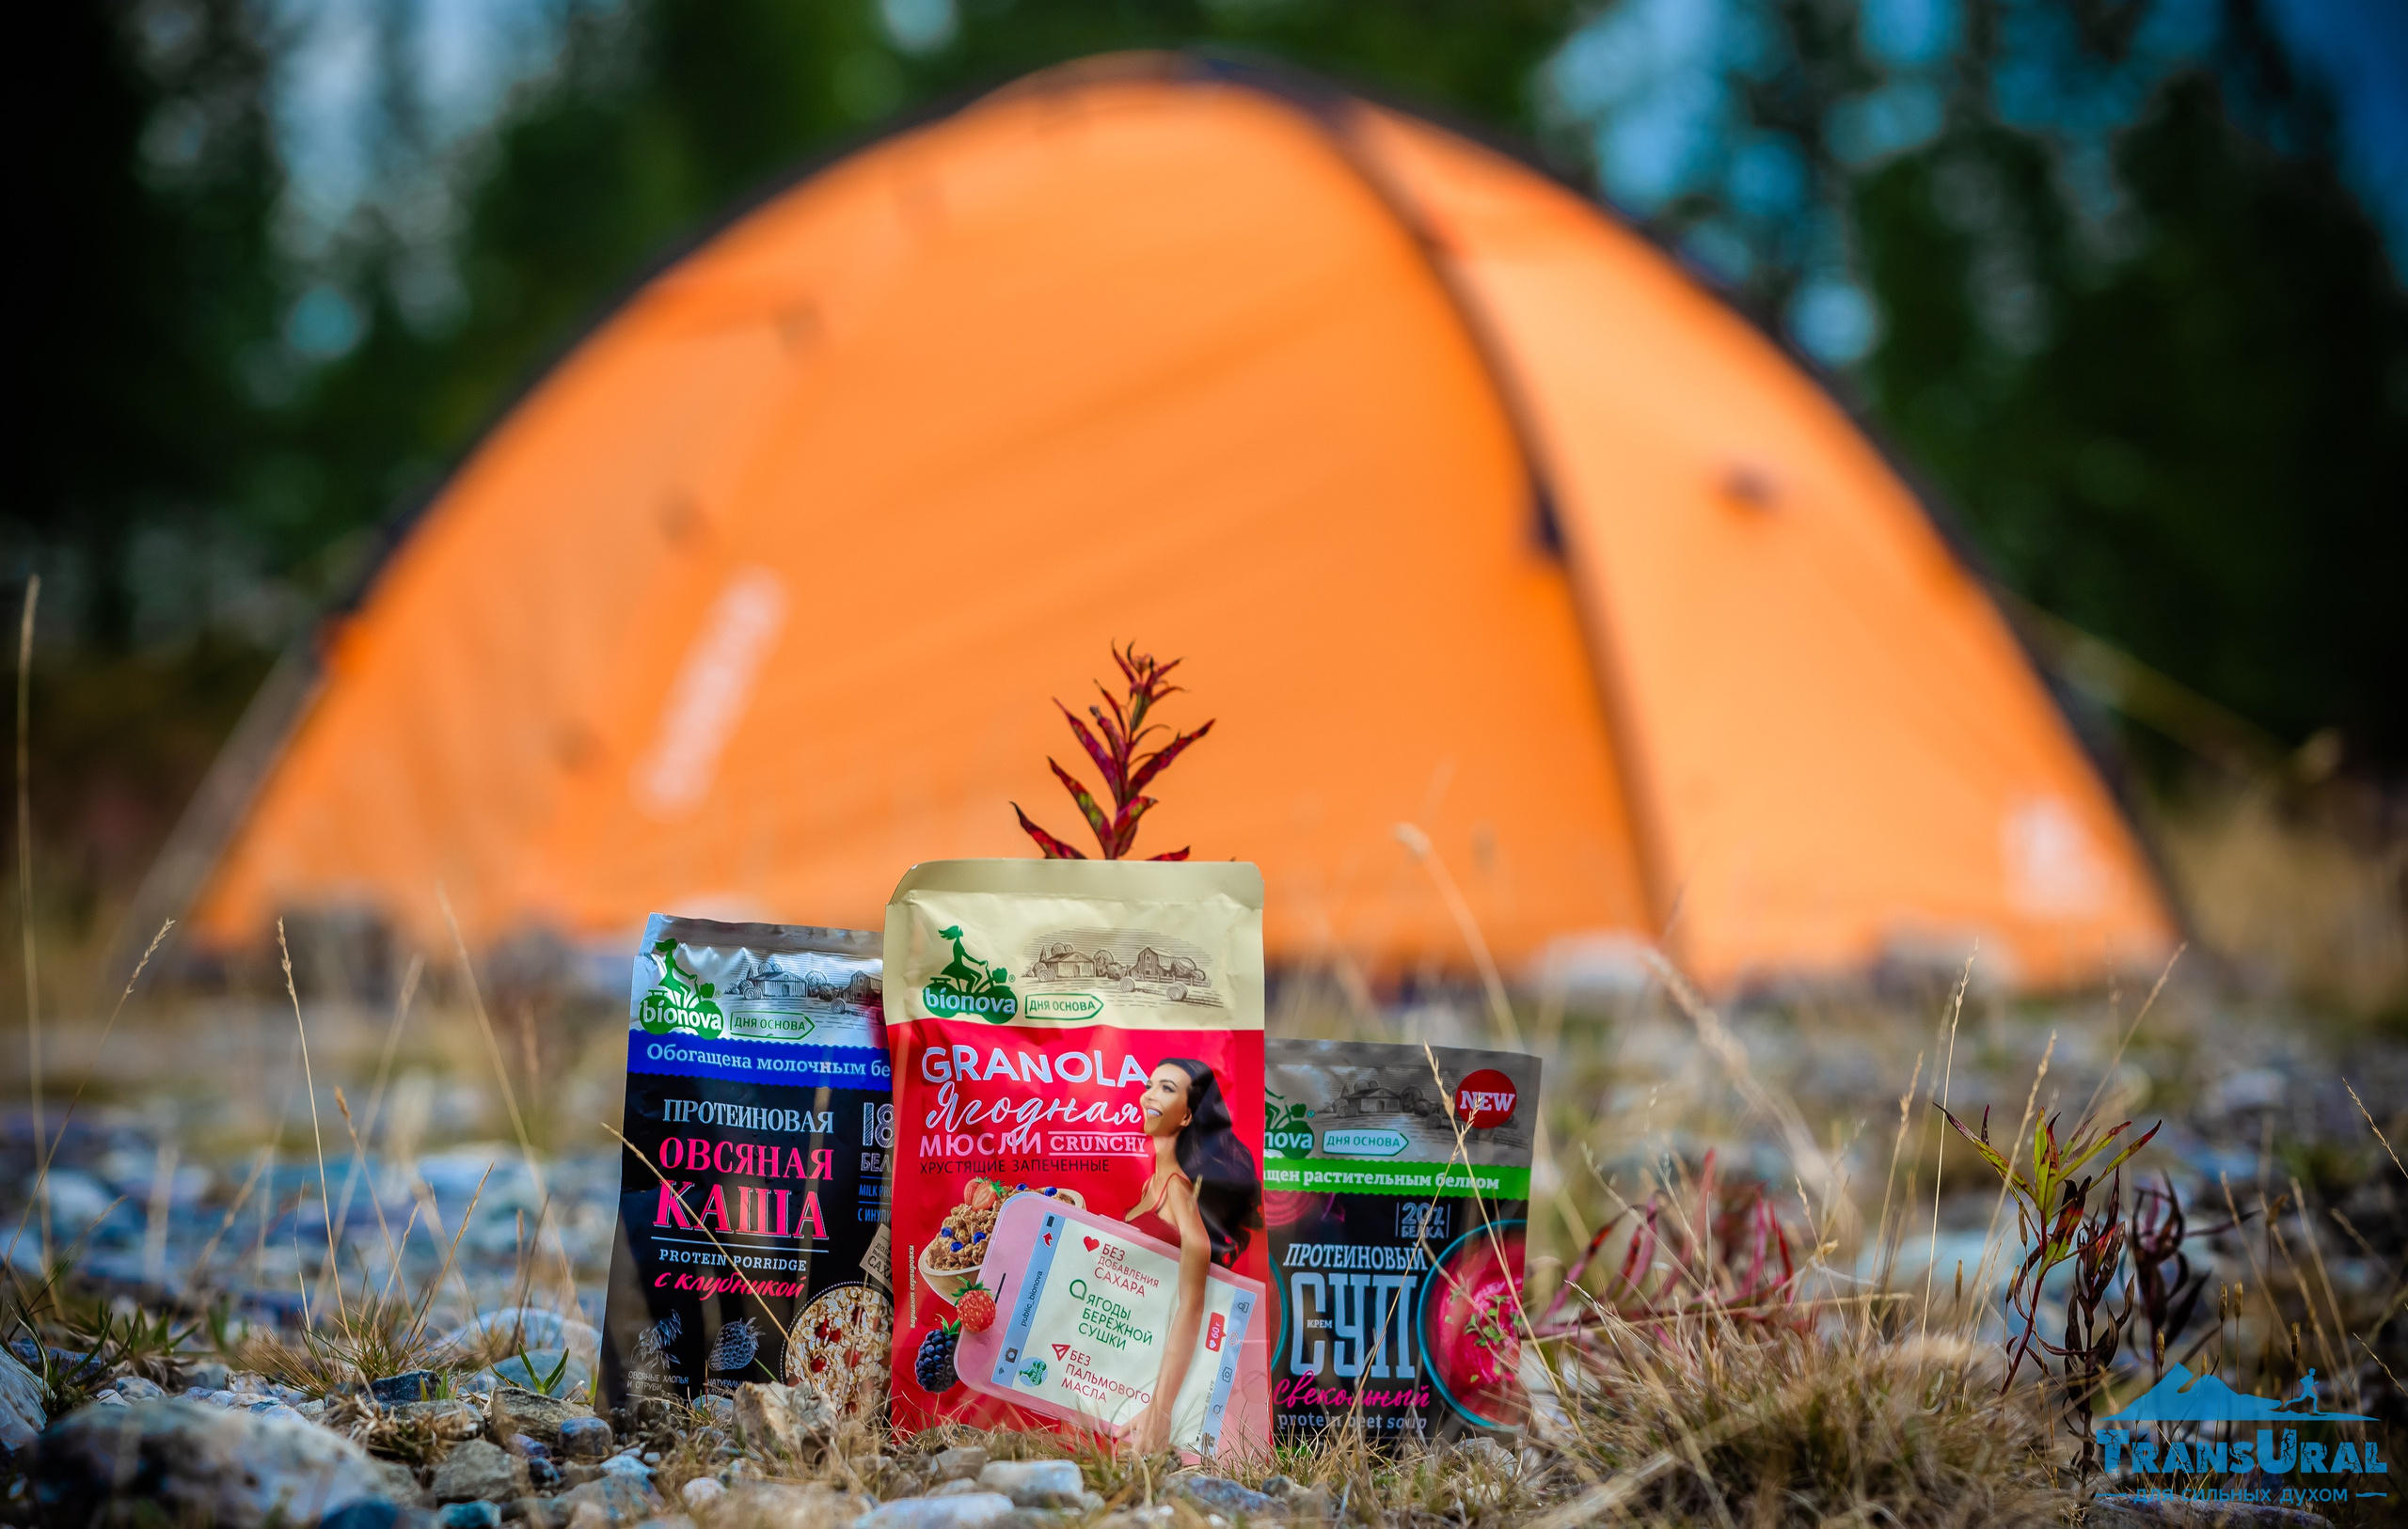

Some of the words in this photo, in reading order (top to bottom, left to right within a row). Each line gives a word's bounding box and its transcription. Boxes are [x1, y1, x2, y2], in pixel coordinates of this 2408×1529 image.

[926, 988, 1017, 1015] bionova
[1029, 1000, 1051, 1012] ДНЯ
[1053, 999, 1096, 1012] ОСНОВА
[643, 1001, 722, 1032] bionova
[735, 1017, 757, 1029] ДНЯ
[760, 1018, 806, 1032] ОСНОВА
[647, 1044, 752, 1069] Обогащена
[757, 1057, 865, 1076] молочным
[871, 1064, 891, 1078] бе
[922, 1044, 1149, 1088] GRANOLA
[926, 1081, 1142, 1145] Ягодная
[1460, 1091, 1515, 1111] NEW
[663, 1099, 833, 1134] ПРОТЕИНОВАЯ
[919, 1132, 1041, 1158] МЮСЛИ
[1050, 1135, 1147, 1153] CRUNCHY
[1264, 1131, 1313, 1149] nova
[1326, 1136, 1350, 1146] ДНЯ
[1354, 1136, 1401, 1147] ОСНОВА
[658, 1137, 833, 1180] ОВСЯНАЯ
[861, 1153, 892, 1172] БЕЛ
[920, 1160, 1006, 1174] ХРУСТЯЩИЕ
[1012, 1159, 1110, 1173] ЗАПЕЧЕННЫЕ
[859, 1184, 879, 1197] MILK
[1303, 1171, 1432, 1189] растительным
[1435, 1171, 1499, 1190] белком
[653, 1180, 830, 1240] КАША
[1402, 1202, 1445, 1225] 20%
[659, 1249, 727, 1267] PROTEIN
[733, 1254, 807, 1271] PORRIDGE
[1101, 1243, 1125, 1261] БЕЗ
[1283, 1241, 1429, 1270] ПРОТЕИНОВЫЙ
[1094, 1267, 1145, 1298] САХАРА
[1098, 1256, 1159, 1288] ДОБАВЛЕНИЯ
[674, 1273, 806, 1300] клубникой
[1021, 1270, 1043, 1327] public_bionova
[1086, 1294, 1132, 1321] ЯГОДЫ
[1078, 1322, 1127, 1351] СУШКИ
[1083, 1308, 1152, 1346] БЕРЕЖНОЙ
[1290, 1272, 1418, 1379] СУП
[1307, 1319, 1333, 1329] КРЕМ
[1069, 1349, 1091, 1366] БЕЗ
[628, 1370, 659, 1382] ОВСЯНЫЕ
[663, 1375, 689, 1384] ХЛОПЬЯ
[1066, 1363, 1150, 1404] ПАЛЬМОВОГО
[1061, 1378, 1107, 1403] МАСЛА
[1277, 1412, 1342, 1430] protein
[1387, 1416, 1427, 1431] soup
